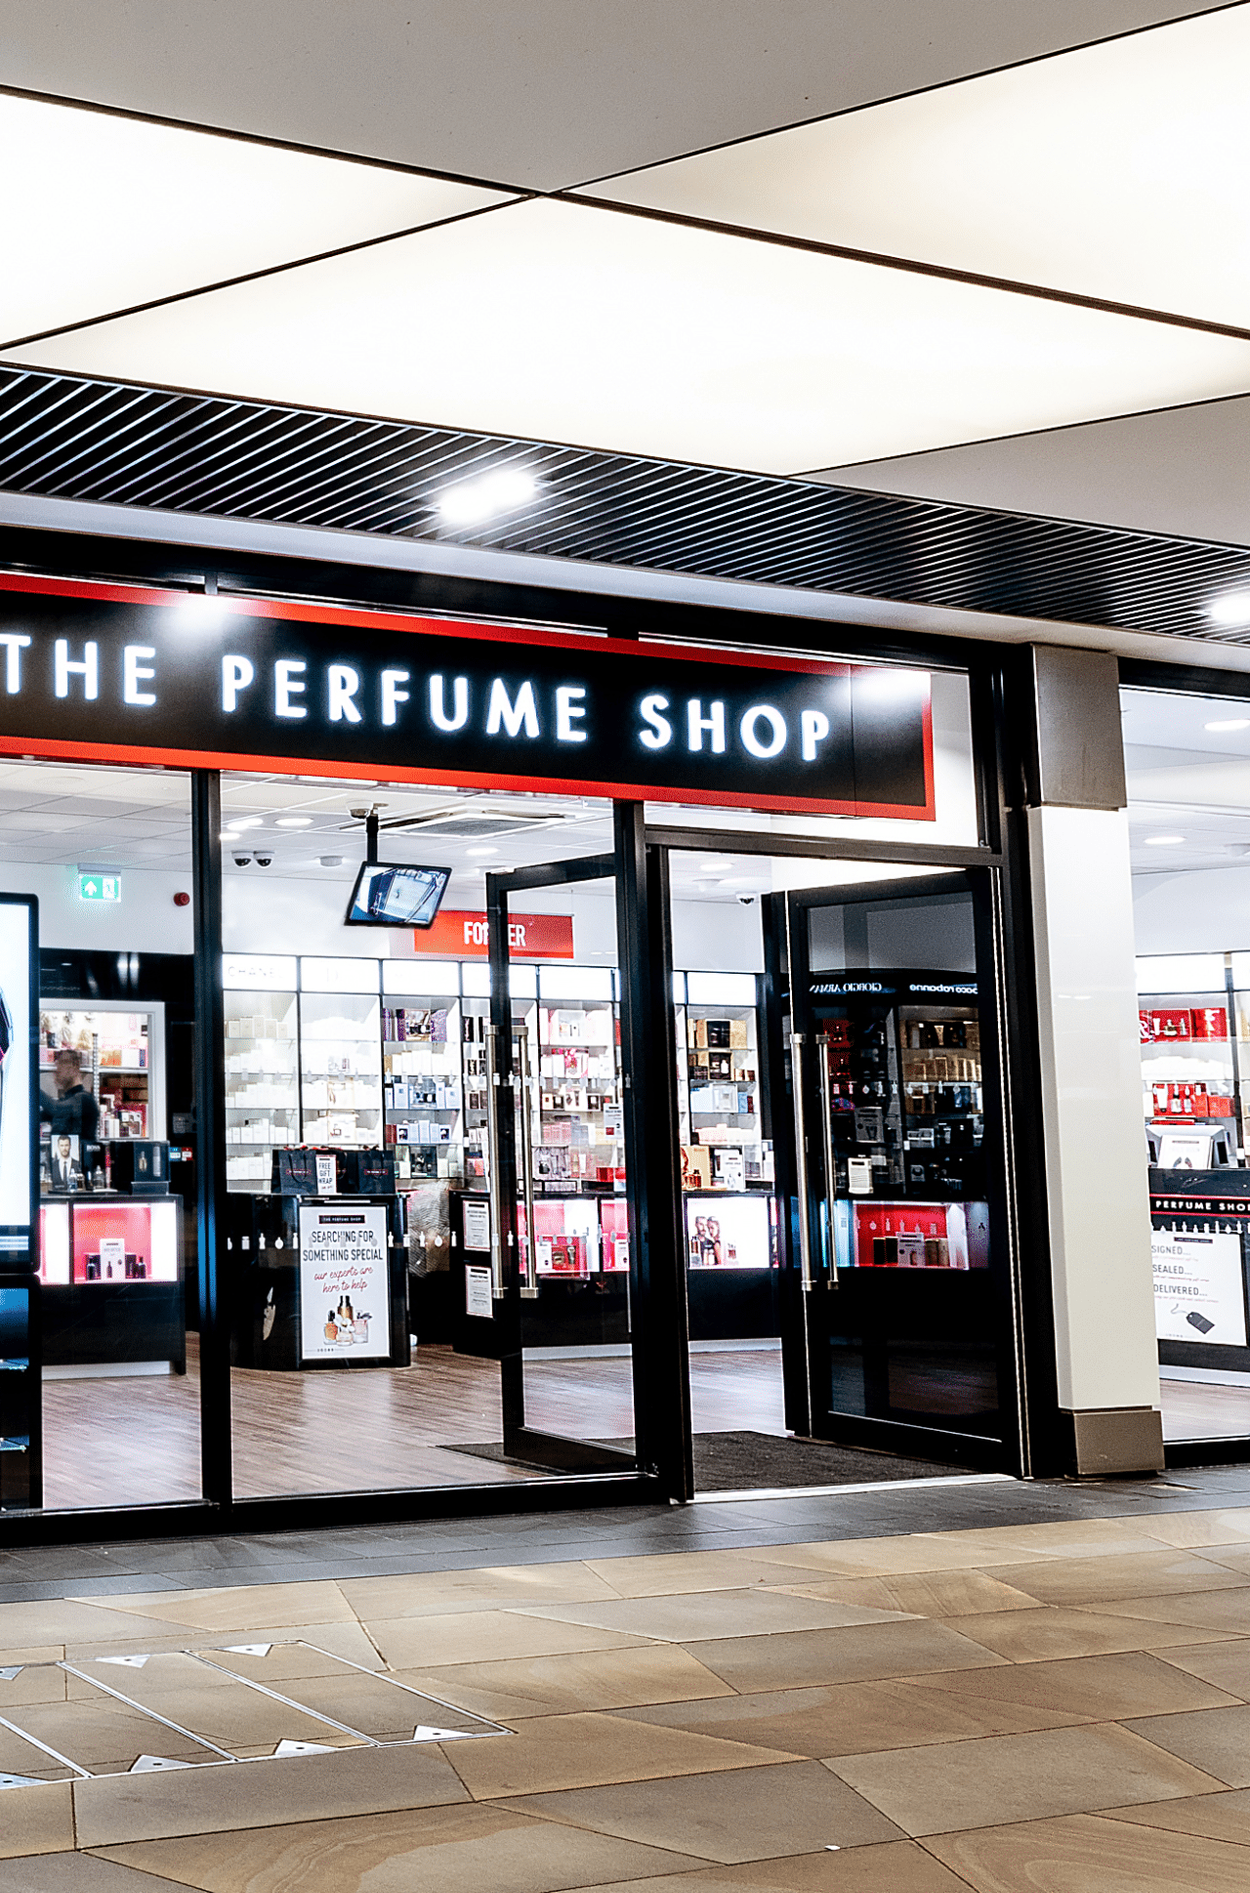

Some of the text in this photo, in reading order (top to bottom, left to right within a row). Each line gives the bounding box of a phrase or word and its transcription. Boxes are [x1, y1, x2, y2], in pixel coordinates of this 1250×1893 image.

[221, 654, 587, 742] PERFUME
[638, 695, 831, 761] SHOP
[464, 921, 526, 947] FOR ER
[228, 965, 283, 979] CHANE
[319, 1162, 331, 1170] FREE
[1156, 1200, 1212, 1210] PERFUME
[311, 1230, 374, 1243] SEARCHING FOR
[303, 1248, 384, 1261] SOMETHING SPECIAL
[314, 1265, 374, 1281] our experts are
[322, 1278, 368, 1293] here to help
